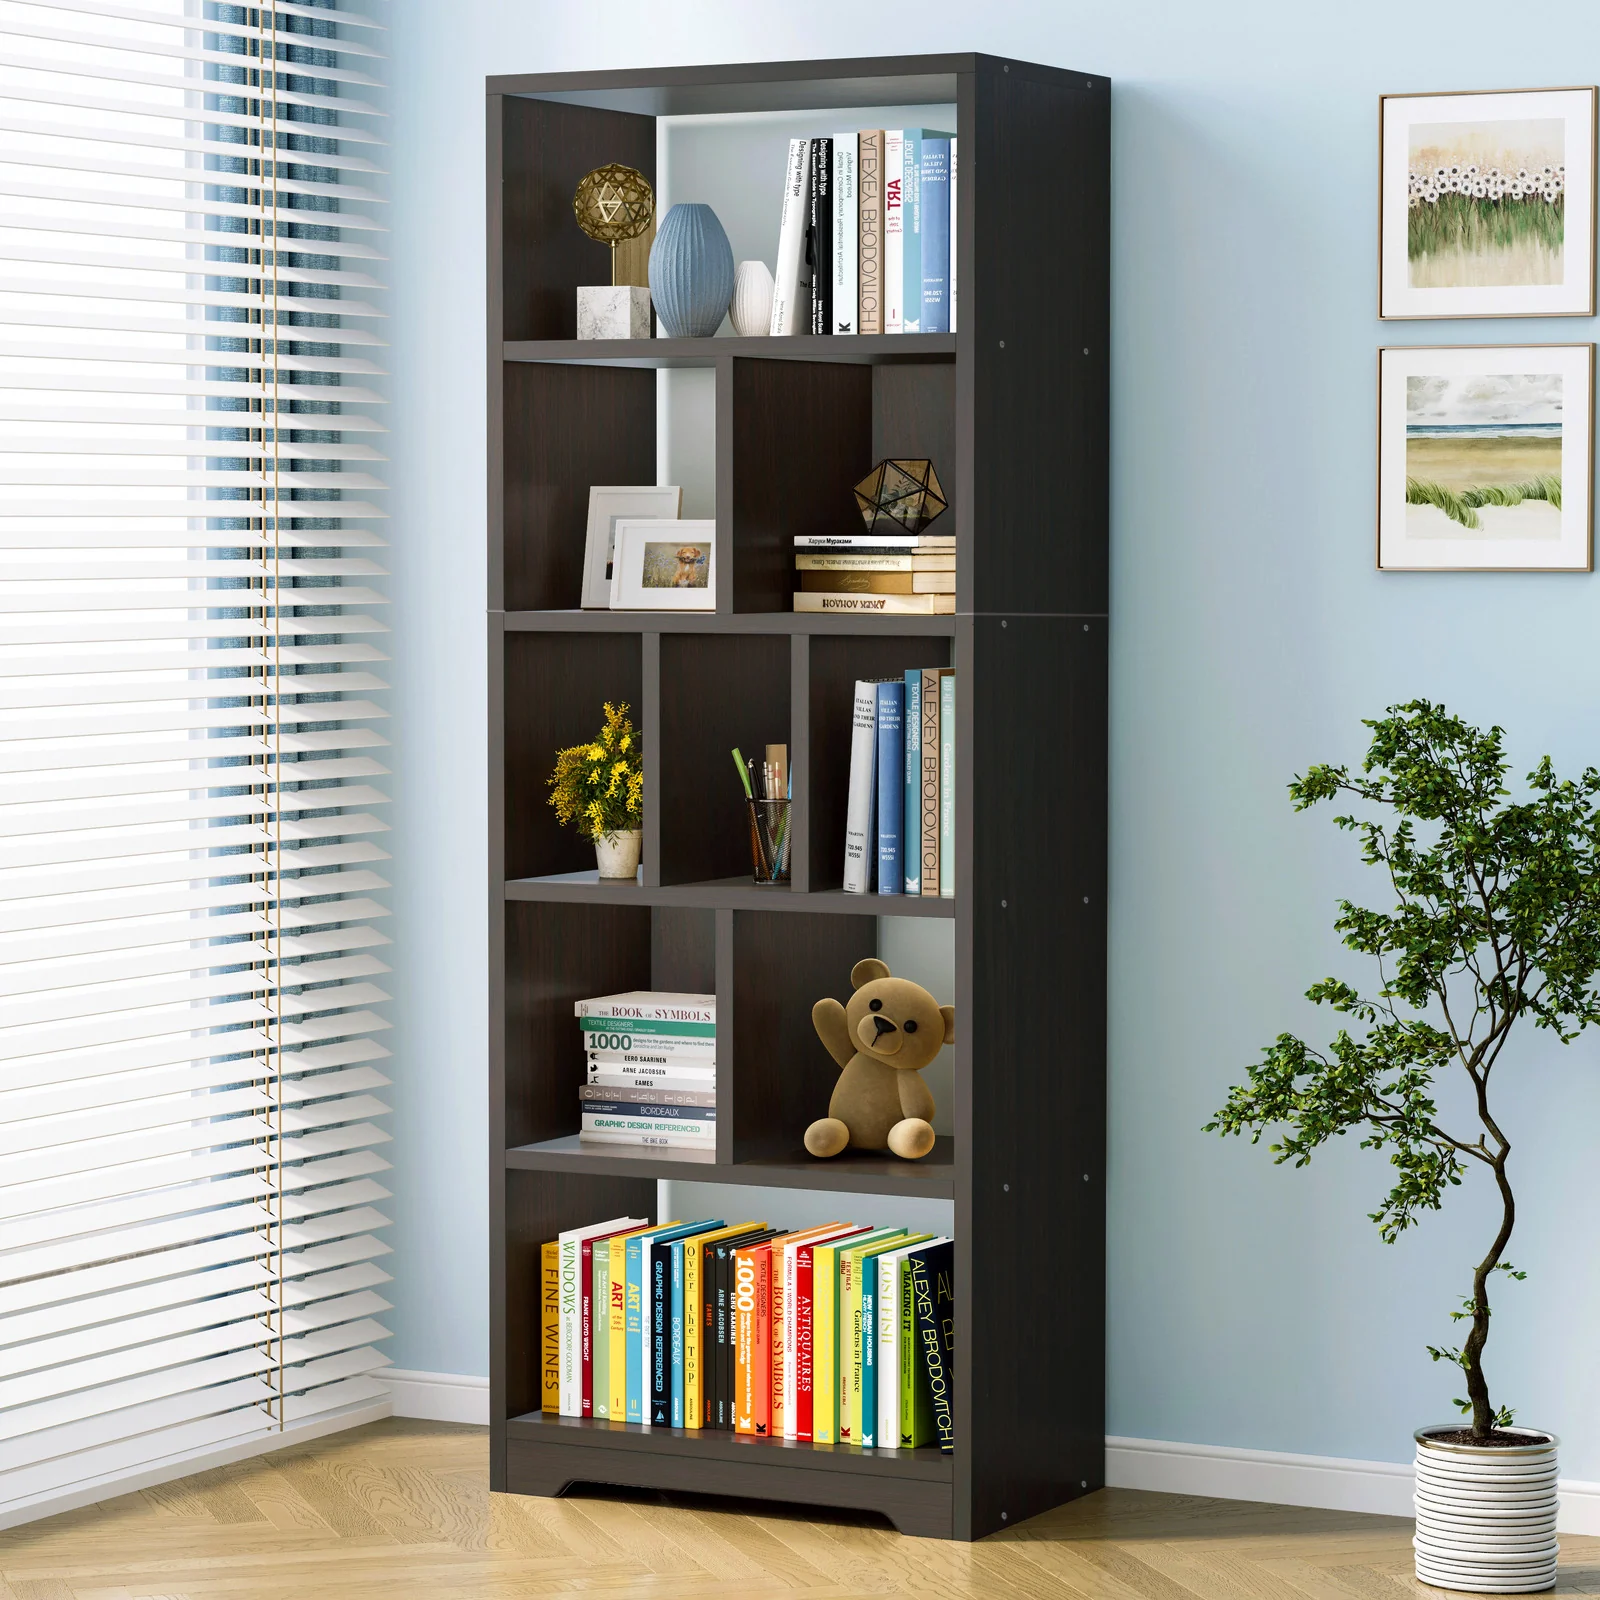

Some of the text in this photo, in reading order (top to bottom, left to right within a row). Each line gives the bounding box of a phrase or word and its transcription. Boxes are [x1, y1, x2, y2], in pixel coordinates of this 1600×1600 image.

[793, 141, 806, 197] Designing with type
[818, 139, 828, 196] Designing with type
[822, 598, 886, 609] ДЖЕК ЛОНДОН
[911, 682, 920, 751] TEXTILE DESIGNERS
[924, 676, 937, 751] ALEXEY
[942, 743, 952, 837] Gardens in France
[924, 757, 937, 881] BRODOVITCH
[847, 843, 863, 851] 720.945
[588, 1019, 634, 1028] TEXTILE DESIGNERS
[612, 1006, 643, 1018] BOOK
[655, 1009, 711, 1022] SYMBOLS
[589, 1033, 633, 1051] 1000
[594, 1119, 701, 1133] GRAPHIC DESIGN REFERENCED
[640, 1106, 679, 1117] BORDEAUX
[642, 1136, 650, 1144] THE
[545, 1268, 559, 1314] FINE
[562, 1241, 575, 1315] WINDOWS
[611, 1281, 623, 1311] ART
[627, 1282, 640, 1312] ART
[655, 1261, 663, 1299] GRAPHIC
[737, 1257, 754, 1312] 1000
[903, 1270, 911, 1332] MAKING IT
[911, 1258, 935, 1324] ALEXEY
[655, 1301, 663, 1333] DESIGN
[686, 1246, 696, 1383] Over the Top
[705, 1303, 713, 1327] EAMES
[773, 1286, 784, 1326] BOOK
[881, 1261, 893, 1343] LOST FISH
[545, 1323, 559, 1390] WINES
[672, 1317, 681, 1365] BORDEAUX
[773, 1328, 778, 1338] OF
[800, 1295, 811, 1392] ANTIQUAIRES
[854, 1350, 861, 1359] in
[655, 1335, 663, 1392] REFERENCED
[773, 1340, 784, 1410] SYMBOLS
[854, 1361, 862, 1393] France
[921, 1329, 954, 1441] BRODOVITCH
